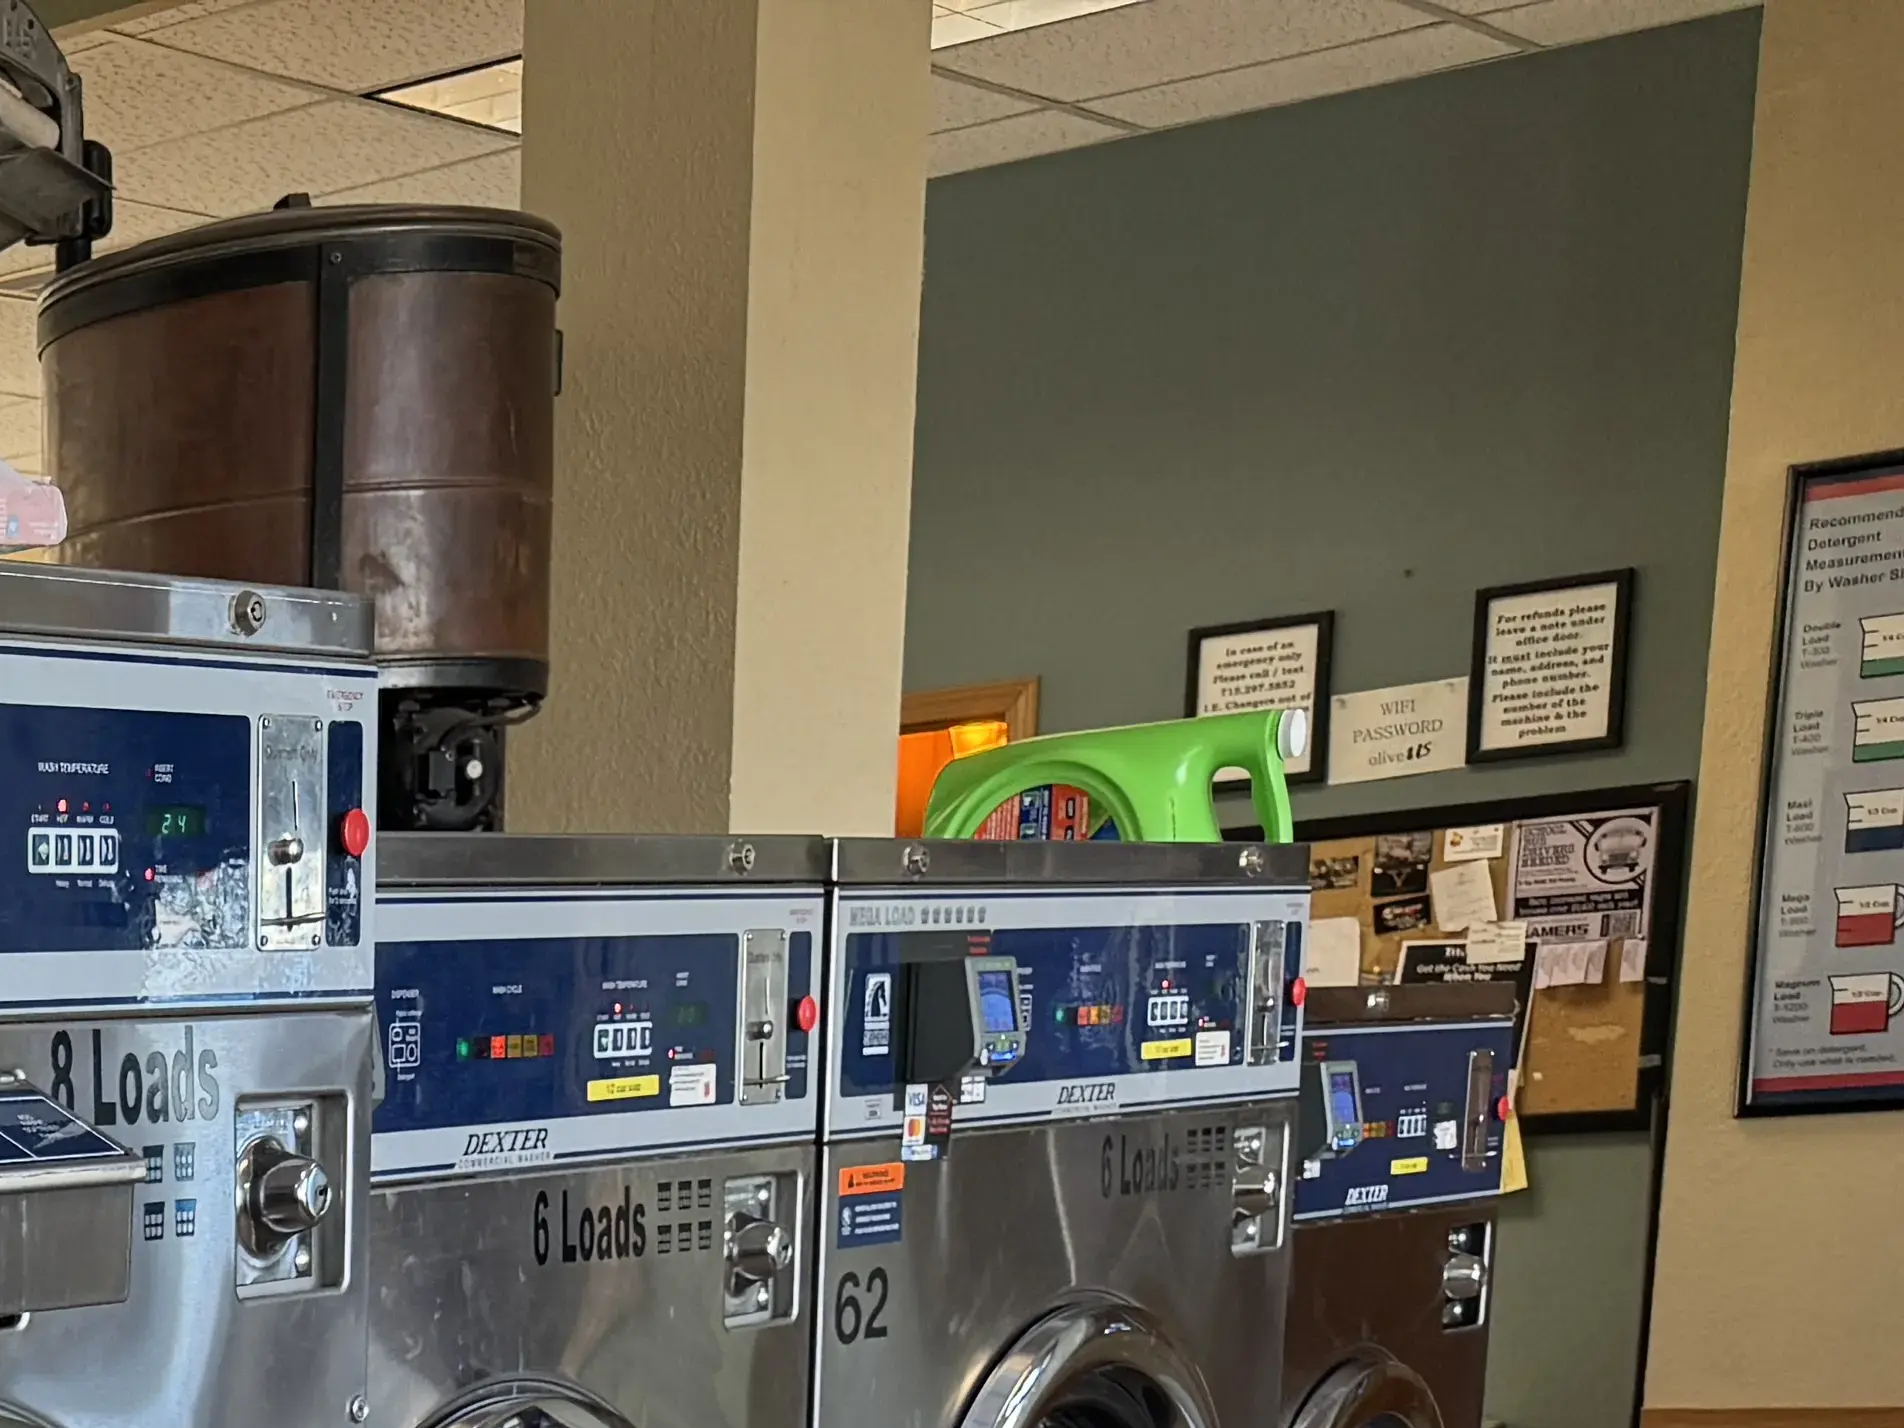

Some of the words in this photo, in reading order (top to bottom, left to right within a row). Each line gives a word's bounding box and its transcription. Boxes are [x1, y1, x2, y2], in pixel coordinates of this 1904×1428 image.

[1808, 531, 1881, 551] Detergent
[1804, 580, 1823, 593] By
[1829, 572, 1886, 589] Washer
[1521, 608, 1565, 622] refunds
[1569, 603, 1605, 617] please
[1535, 645, 1578, 659] include
[1532, 685, 1575, 698] include
[1380, 699, 1415, 715] WIFI
[1501, 713, 1550, 726] machine
[1353, 719, 1443, 744] PASSWORD
[1518, 725, 1566, 739] problem
[60, 762, 109, 775] TEMPERATURE
[161, 814, 186, 834] 24
[849, 906, 882, 926] MEGA
[885, 906, 915, 926] LOAD
[50, 1028, 76, 1113] 8
[91, 1025, 221, 1127] Loads
[1057, 1082, 1115, 1105] DEXTER
[462, 1128, 548, 1157] DEXTER
[458, 1154, 514, 1170] COMMERCIAL
[1102, 1134, 1113, 1200] 6
[1120, 1132, 1179, 1196] Loads
[1345, 1184, 1389, 1206] DEXTER
[534, 1190, 549, 1266] 6
[562, 1185, 646, 1263] Loads
[834, 1267, 888, 1345] 62
